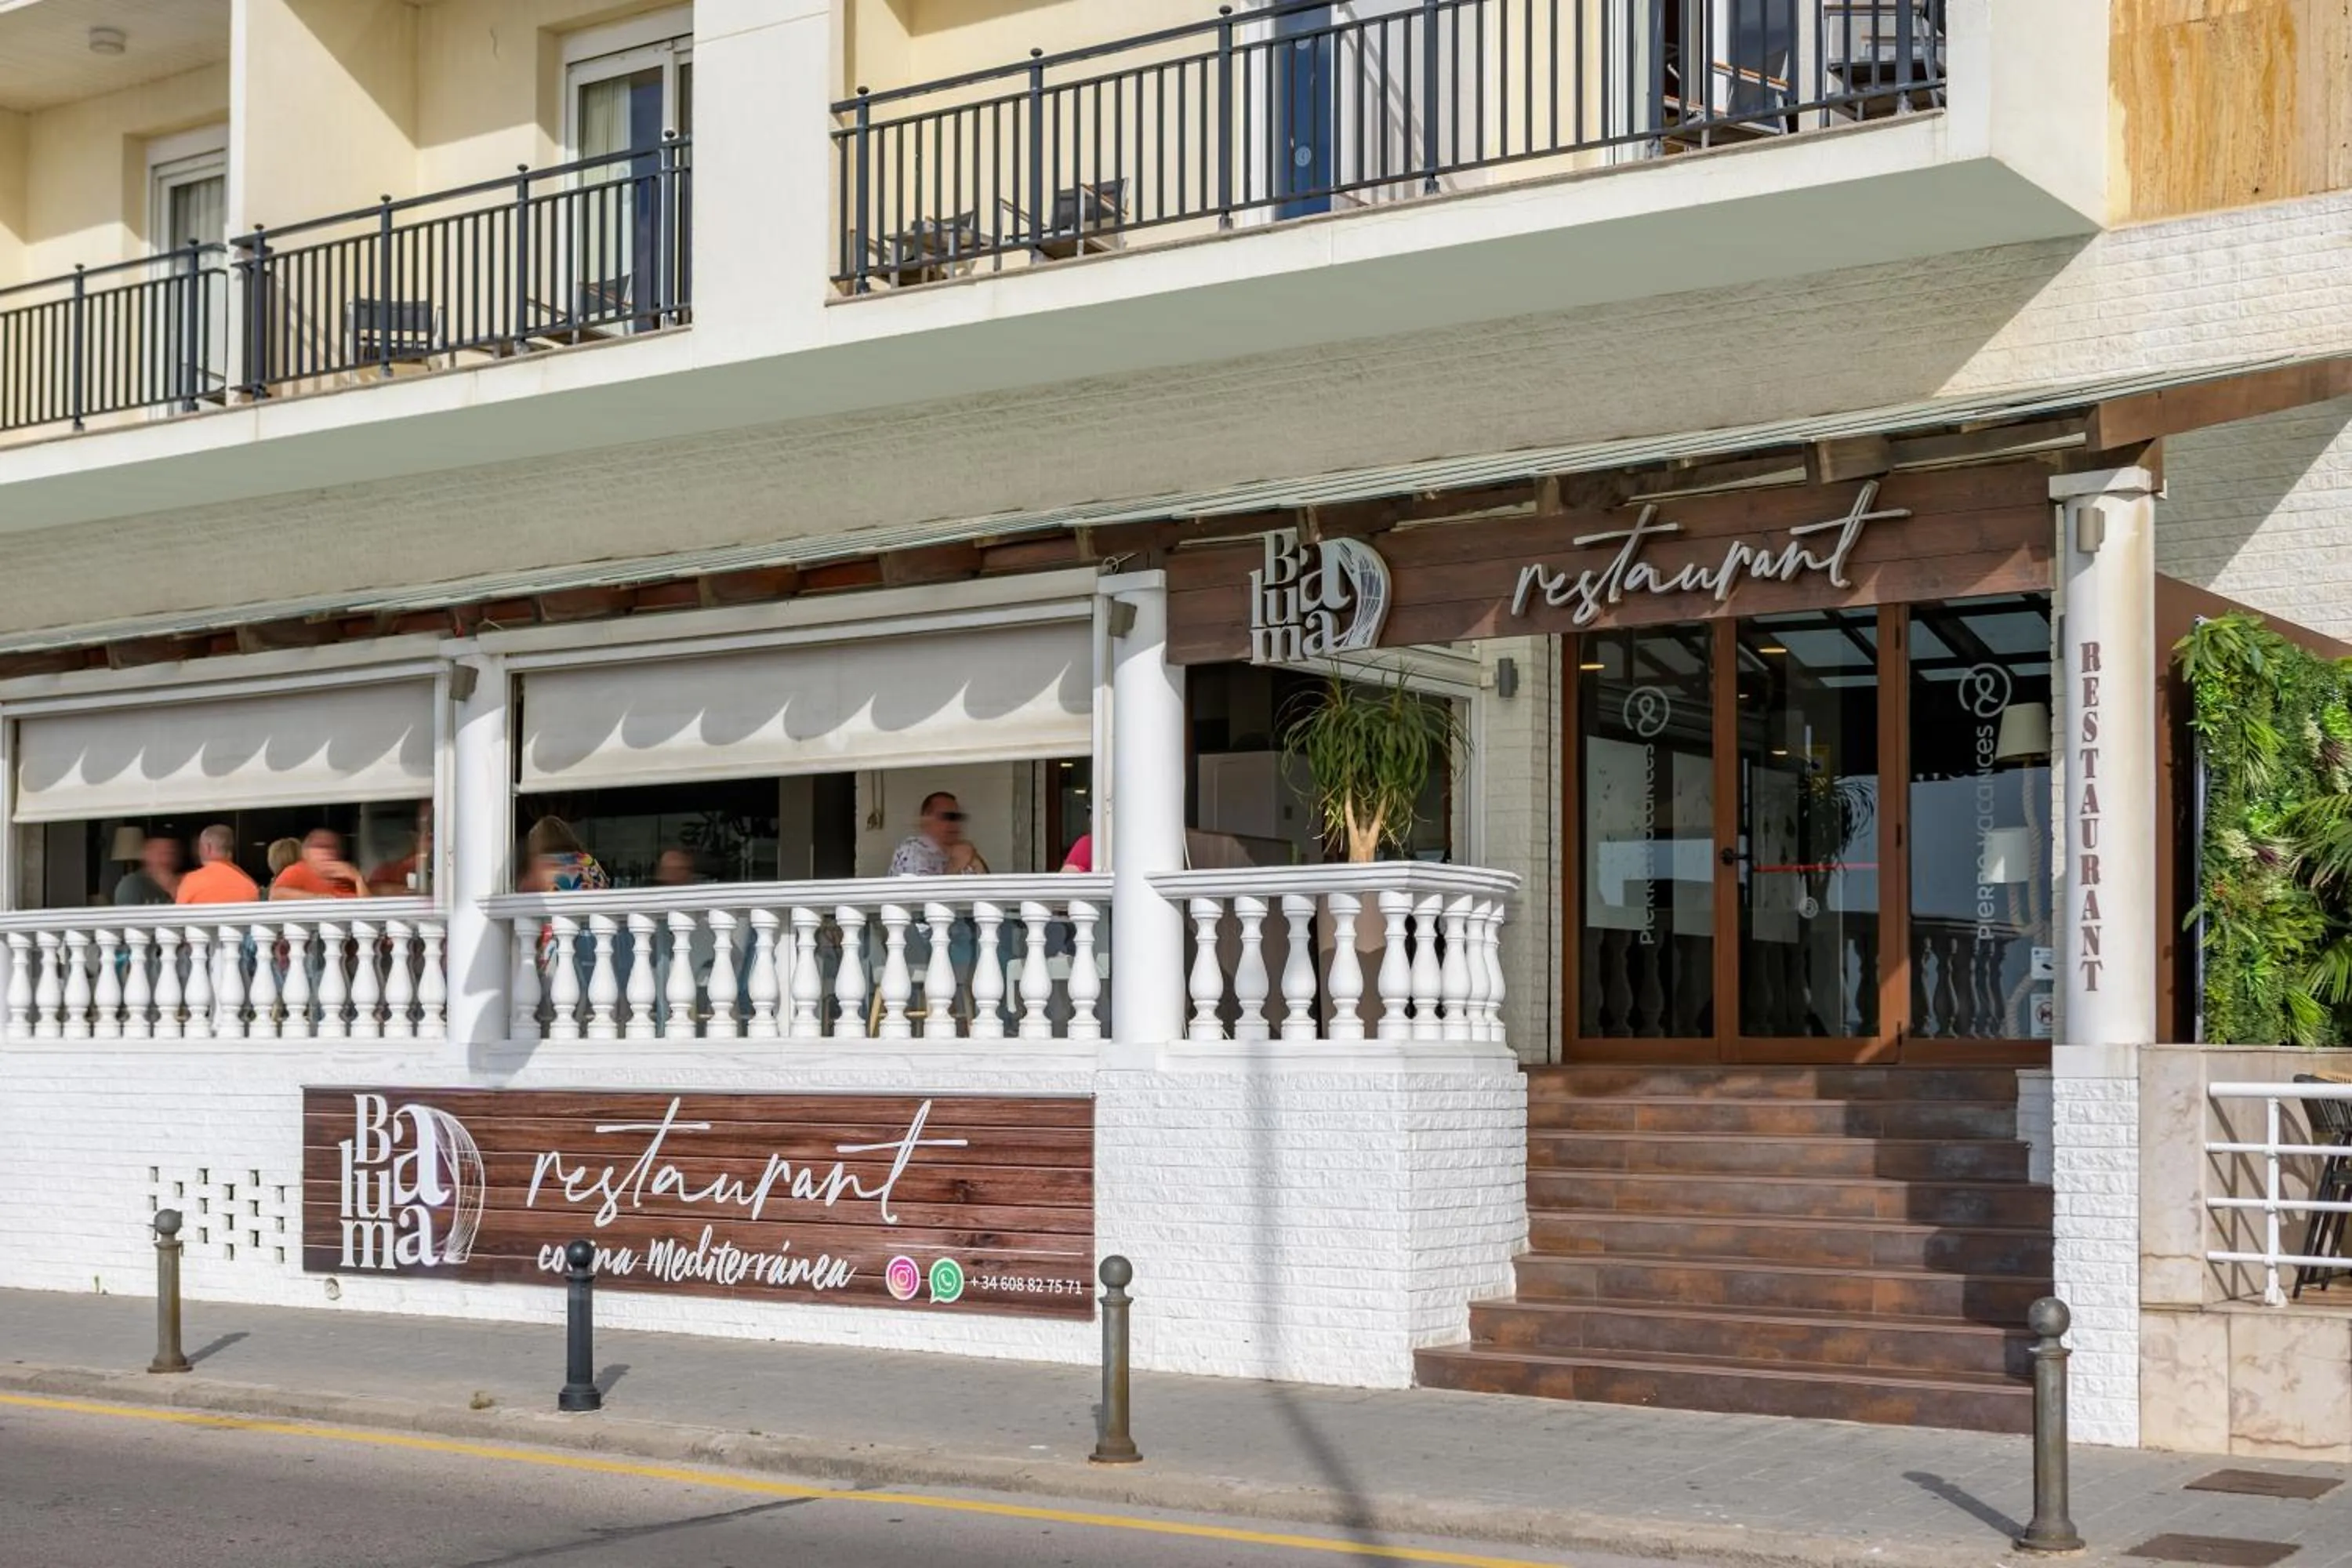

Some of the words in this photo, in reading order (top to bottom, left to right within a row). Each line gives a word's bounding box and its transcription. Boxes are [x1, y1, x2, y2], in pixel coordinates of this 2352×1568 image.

[1511, 480, 1912, 626] restaurant
[2080, 641, 2103, 992] RESTAURANT
[526, 1096, 968, 1229] restaurant
[538, 1240, 641, 1276] cona
[647, 1225, 857, 1290] Mediterránea
[1000, 1276, 1024, 1291] 608
[1027, 1277, 1044, 1293] 82
[1047, 1279, 1063, 1294] 75
[1066, 1279, 1083, 1295] 71
